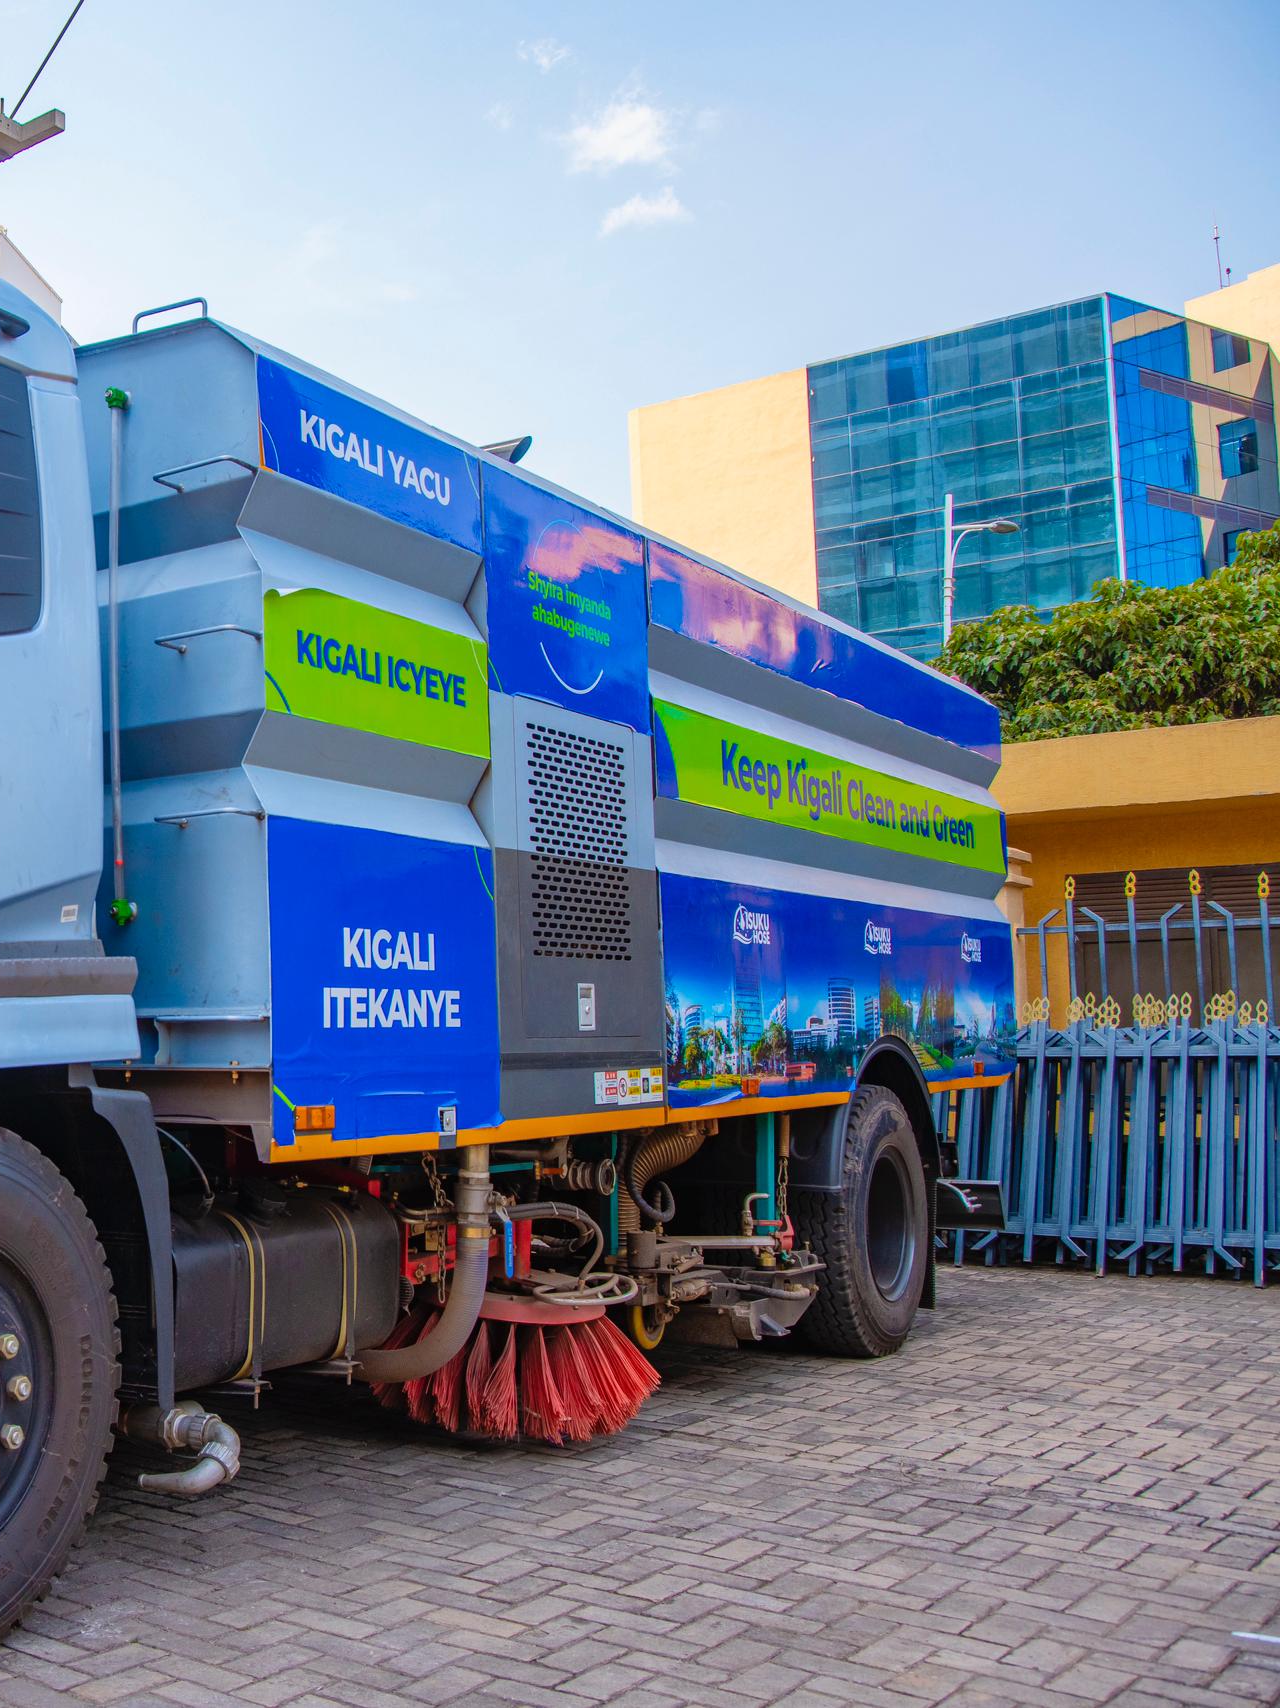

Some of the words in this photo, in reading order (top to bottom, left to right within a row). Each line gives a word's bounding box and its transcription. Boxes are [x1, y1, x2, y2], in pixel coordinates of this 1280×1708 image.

[299, 408, 384, 478] KIGALI
[387, 449, 451, 506] YACU
[527, 570, 564, 602] Shyira
[565, 583, 612, 621] imyanda
[532, 602, 611, 647] ahabugenewe
[296, 629, 382, 685] KIGALI
[388, 655, 467, 709] ICYEYE
[721, 739, 782, 810] Keep
[786, 758, 843, 821] Kigali
[847, 779, 896, 830] Clean
[900, 799, 930, 838] and
[932, 804, 975, 849] Green
[342, 926, 436, 972] KIGALI
[752, 930, 771, 945] HOSE
[878, 941, 892, 955] HOSE
[322, 986, 462, 1029] ITEKANYE
